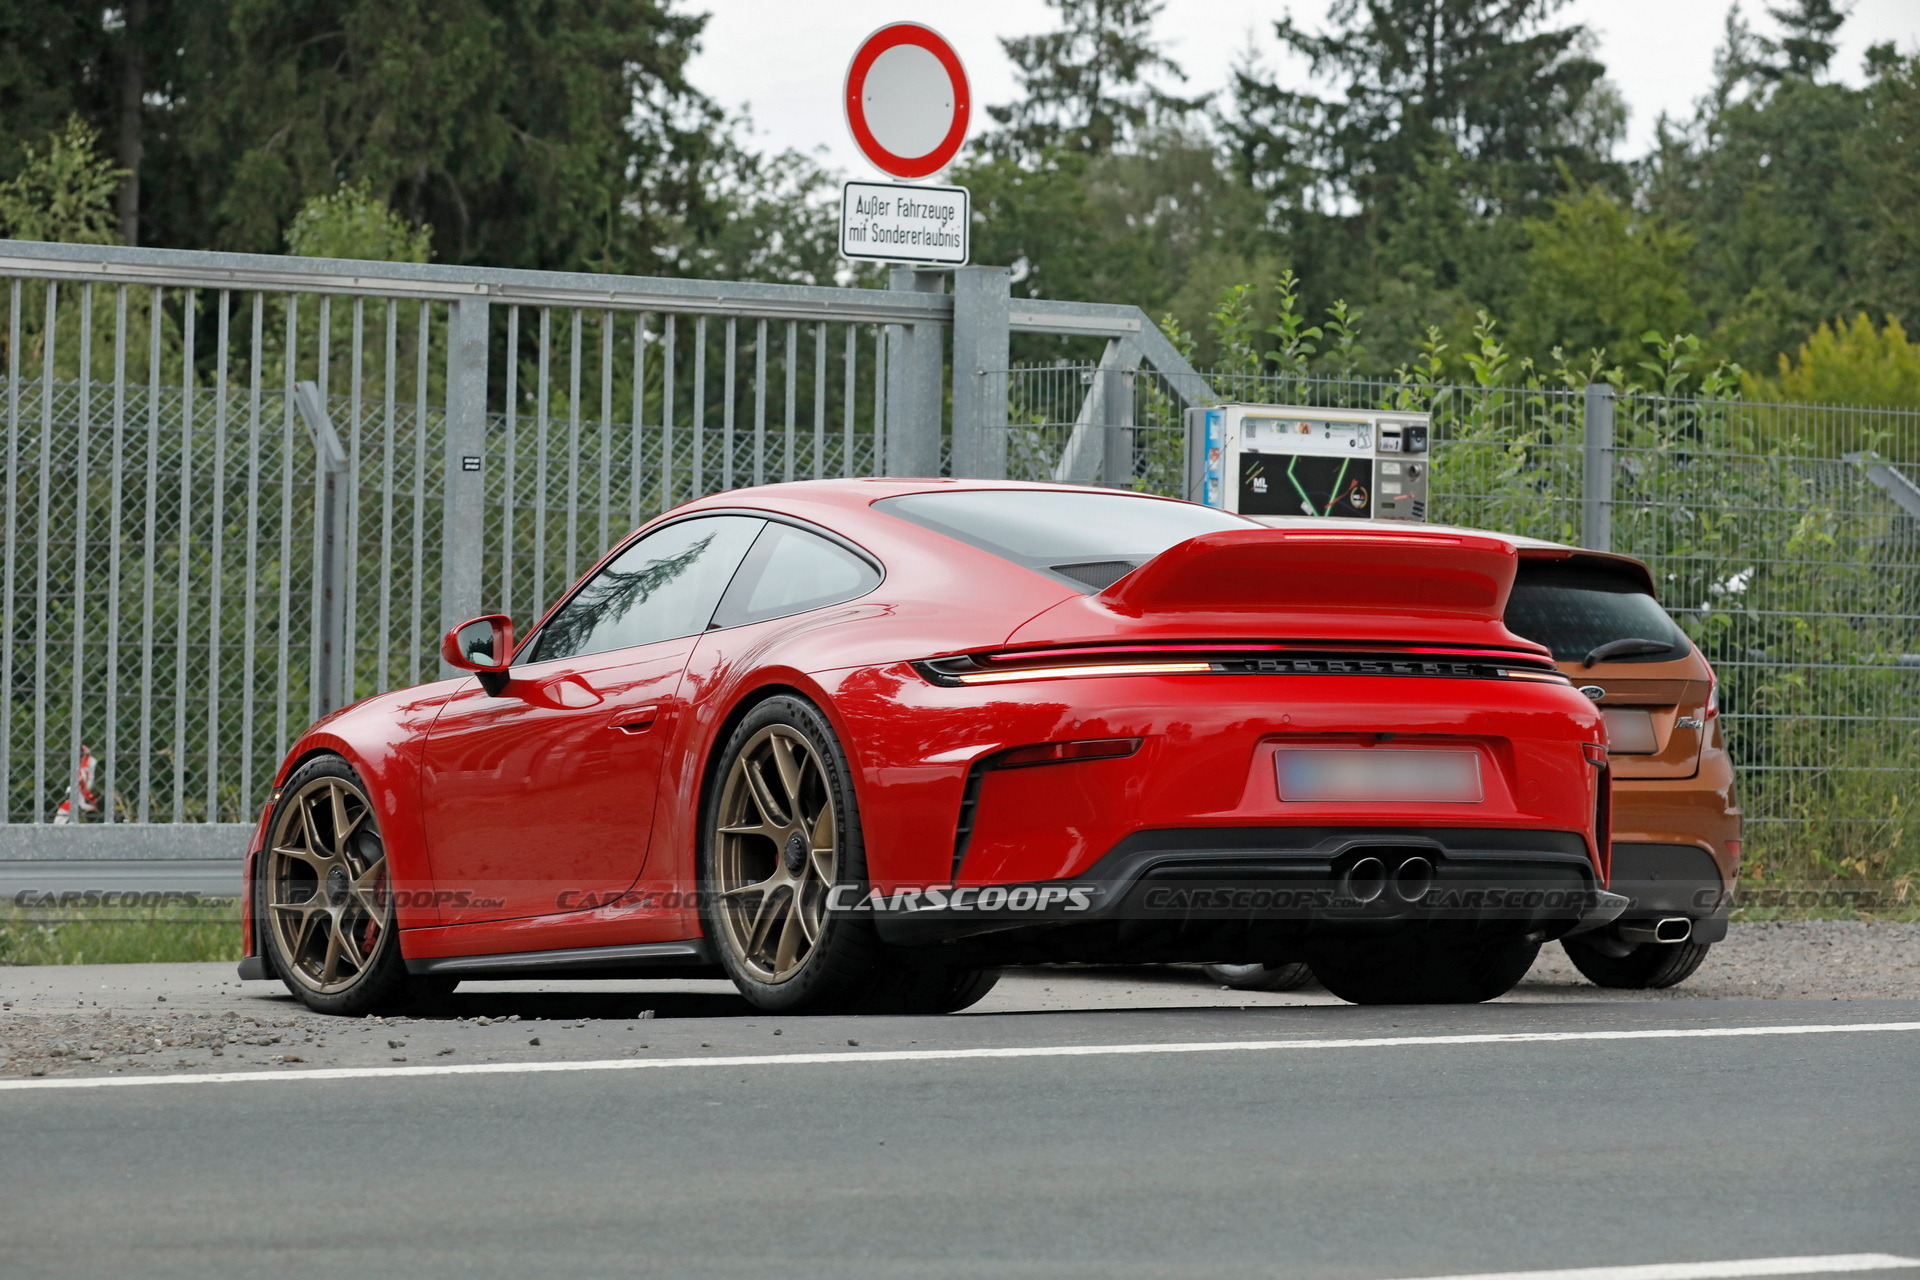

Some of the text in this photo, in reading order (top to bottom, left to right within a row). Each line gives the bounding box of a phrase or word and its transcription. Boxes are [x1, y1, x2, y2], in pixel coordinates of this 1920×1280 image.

[856, 195, 954, 224] Außer Fahrzeuge
[849, 223, 960, 247] mit Sondererlaubnis
[1258, 660, 1468, 674] PORSCHE
[823, 753, 845, 833] MICHELIN
